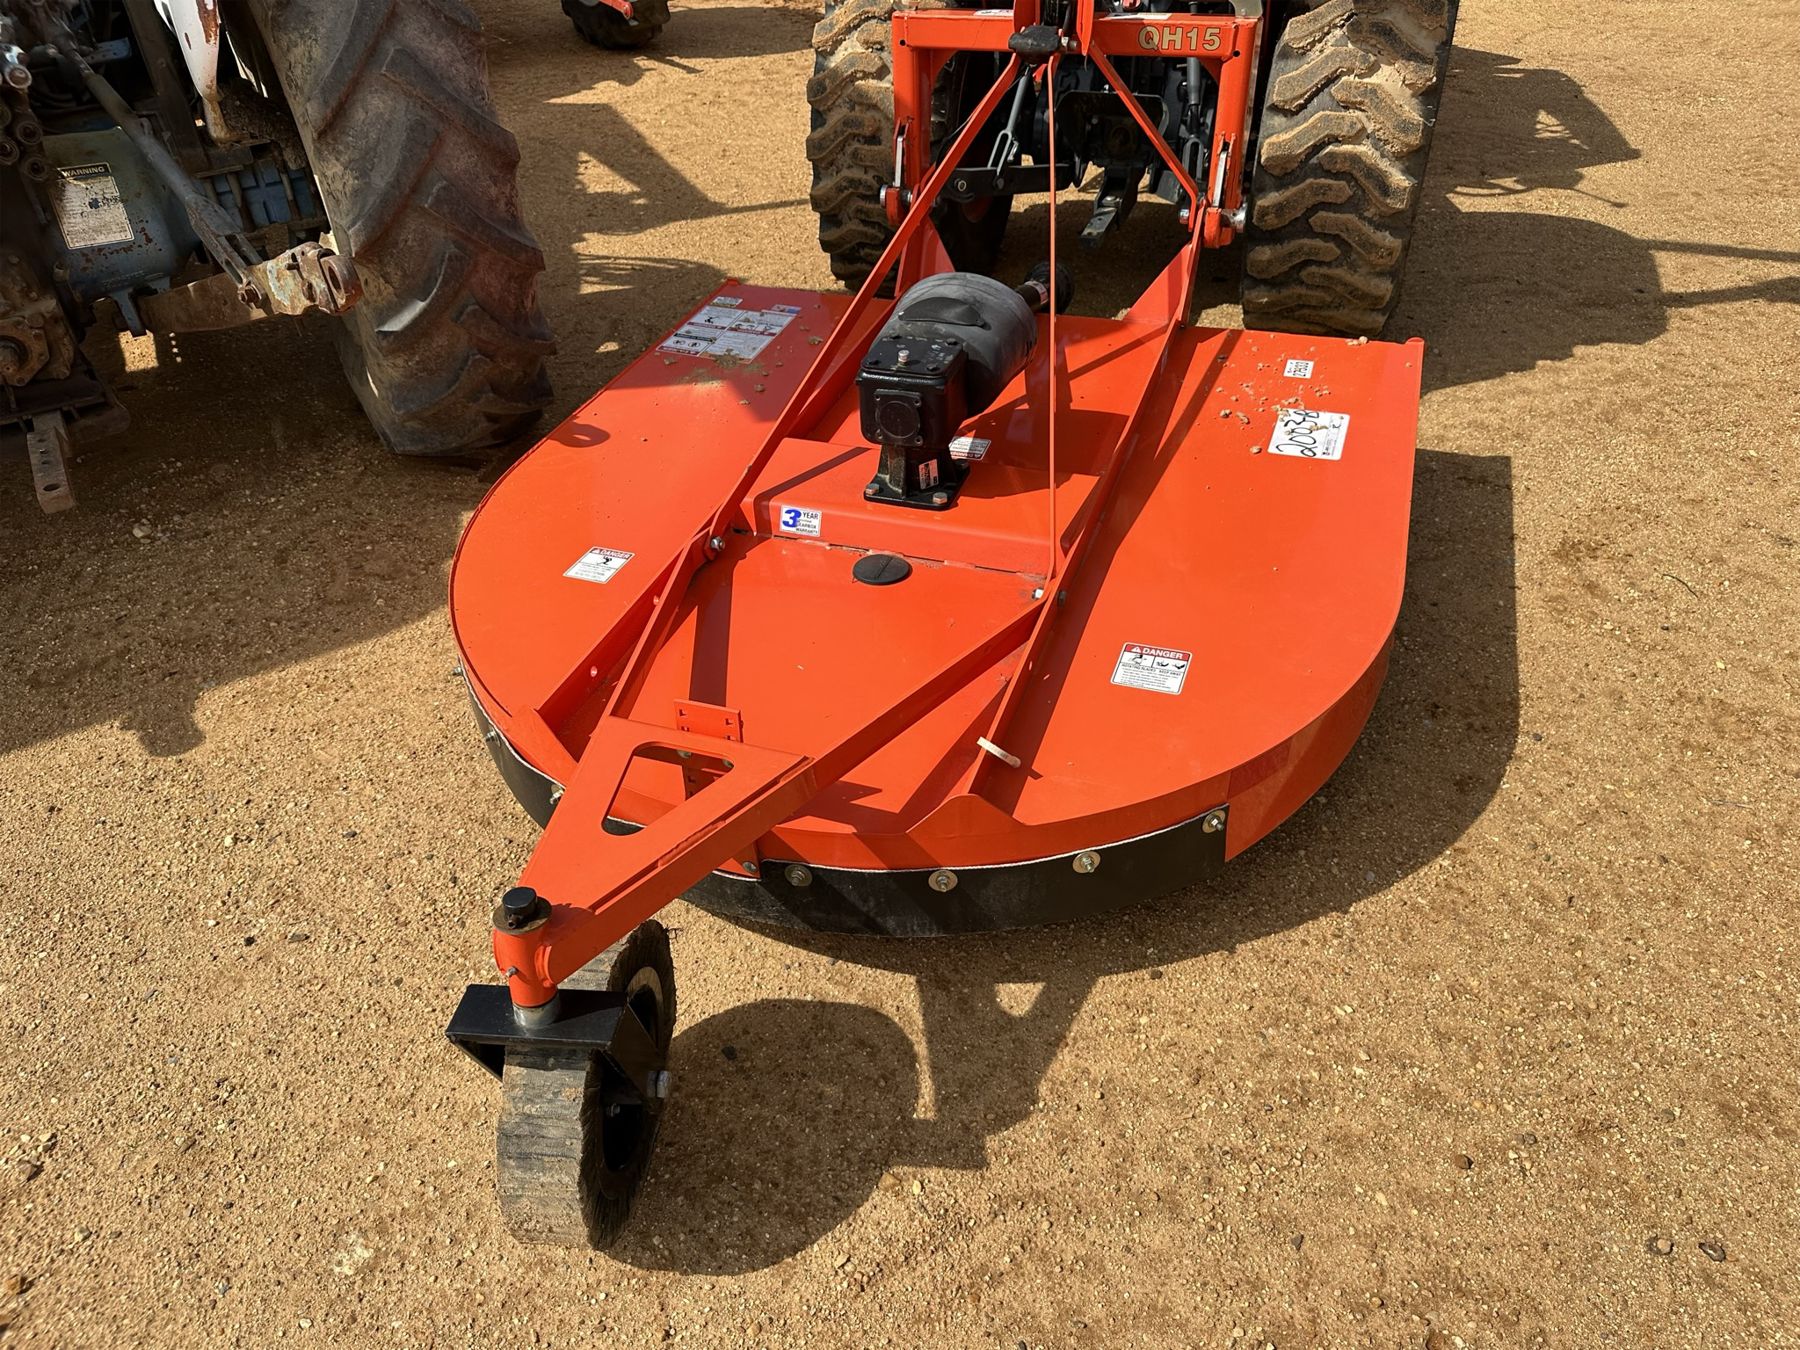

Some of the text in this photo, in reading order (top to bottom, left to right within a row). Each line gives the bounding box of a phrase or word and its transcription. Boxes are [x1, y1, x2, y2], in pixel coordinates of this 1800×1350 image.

[1137, 25, 1221, 51] QH15
[62, 166, 105, 177] WARNING
[783, 509, 819, 528] 3 YEAR
[1142, 647, 1184, 659] DANGER
